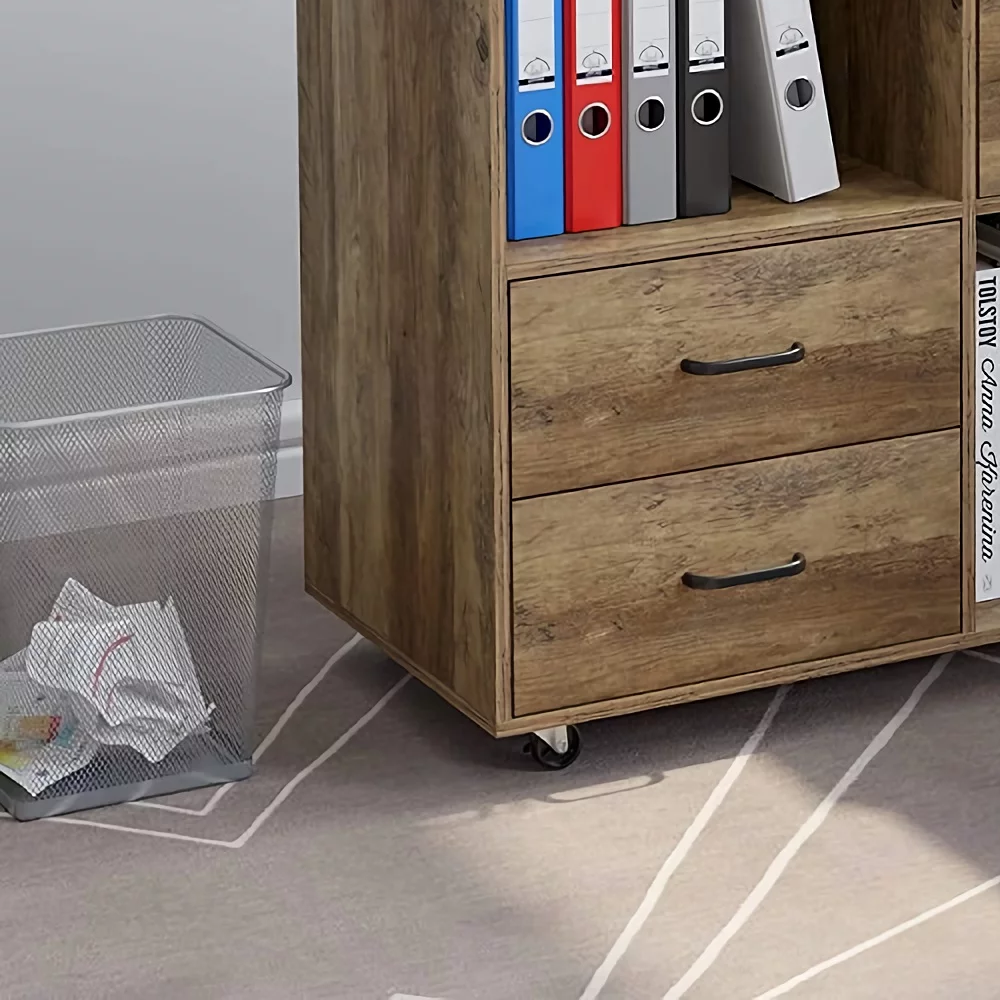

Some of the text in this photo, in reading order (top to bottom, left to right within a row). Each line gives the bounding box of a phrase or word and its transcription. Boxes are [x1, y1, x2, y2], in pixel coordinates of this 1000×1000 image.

[974, 276, 998, 563] TOLSTOY Anna Karenina
